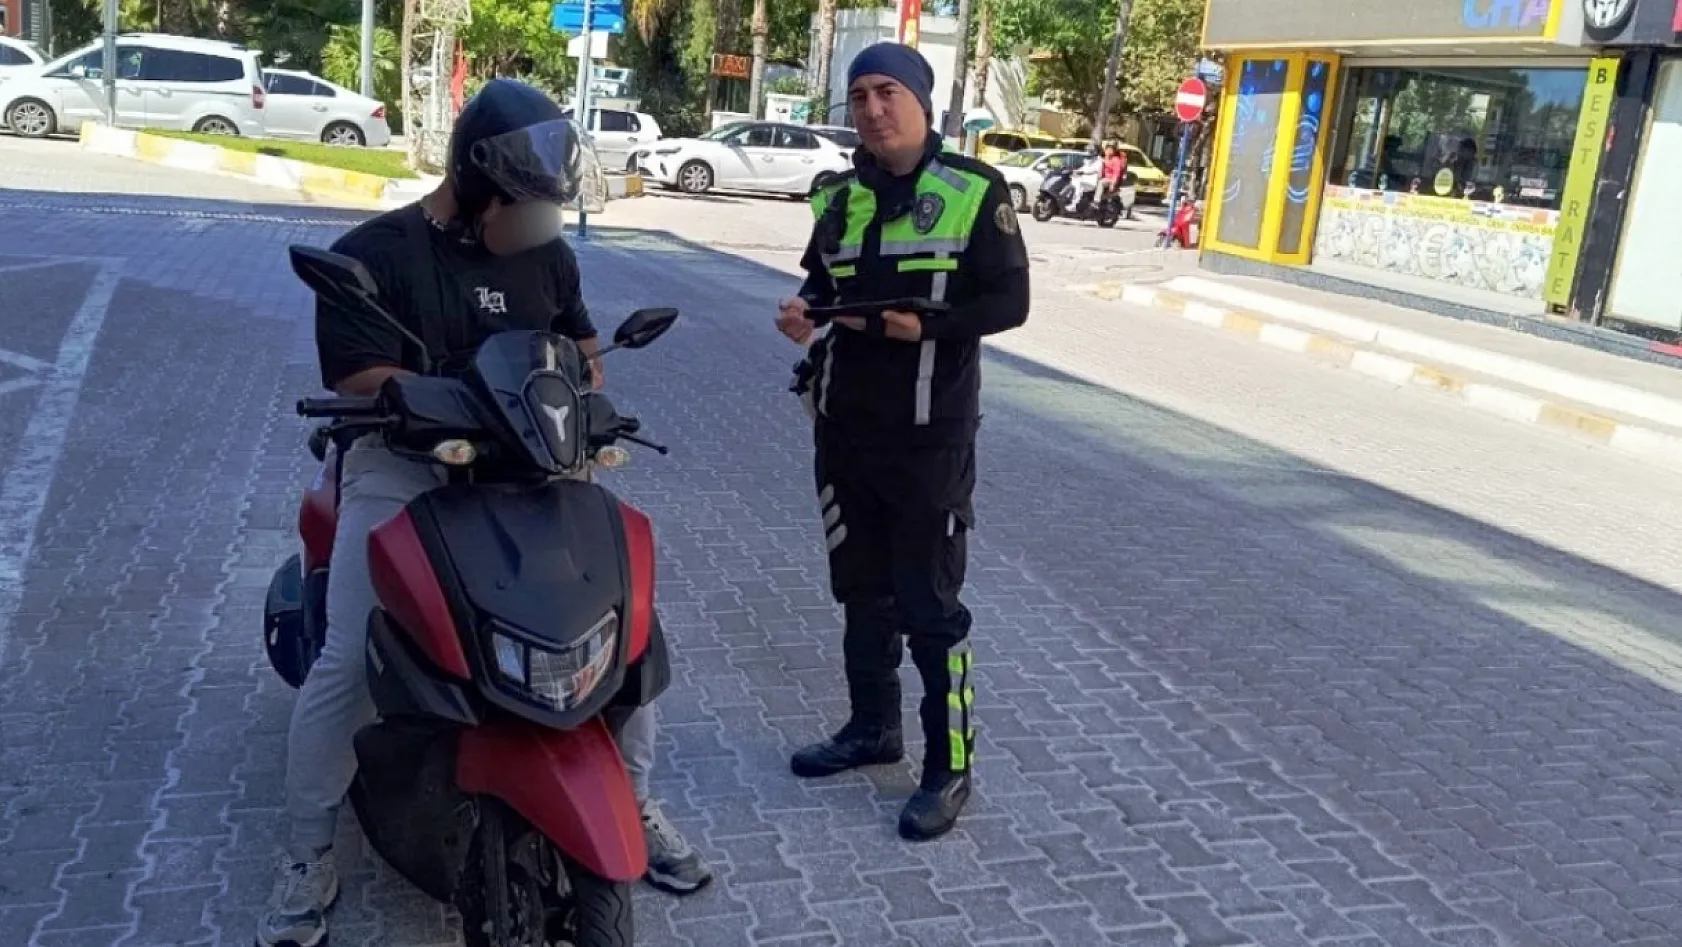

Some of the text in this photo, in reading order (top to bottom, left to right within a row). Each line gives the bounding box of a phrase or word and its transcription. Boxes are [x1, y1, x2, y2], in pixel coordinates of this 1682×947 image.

[716, 56, 748, 73] TAXI
[1551, 68, 1607, 295] BEST RATE
